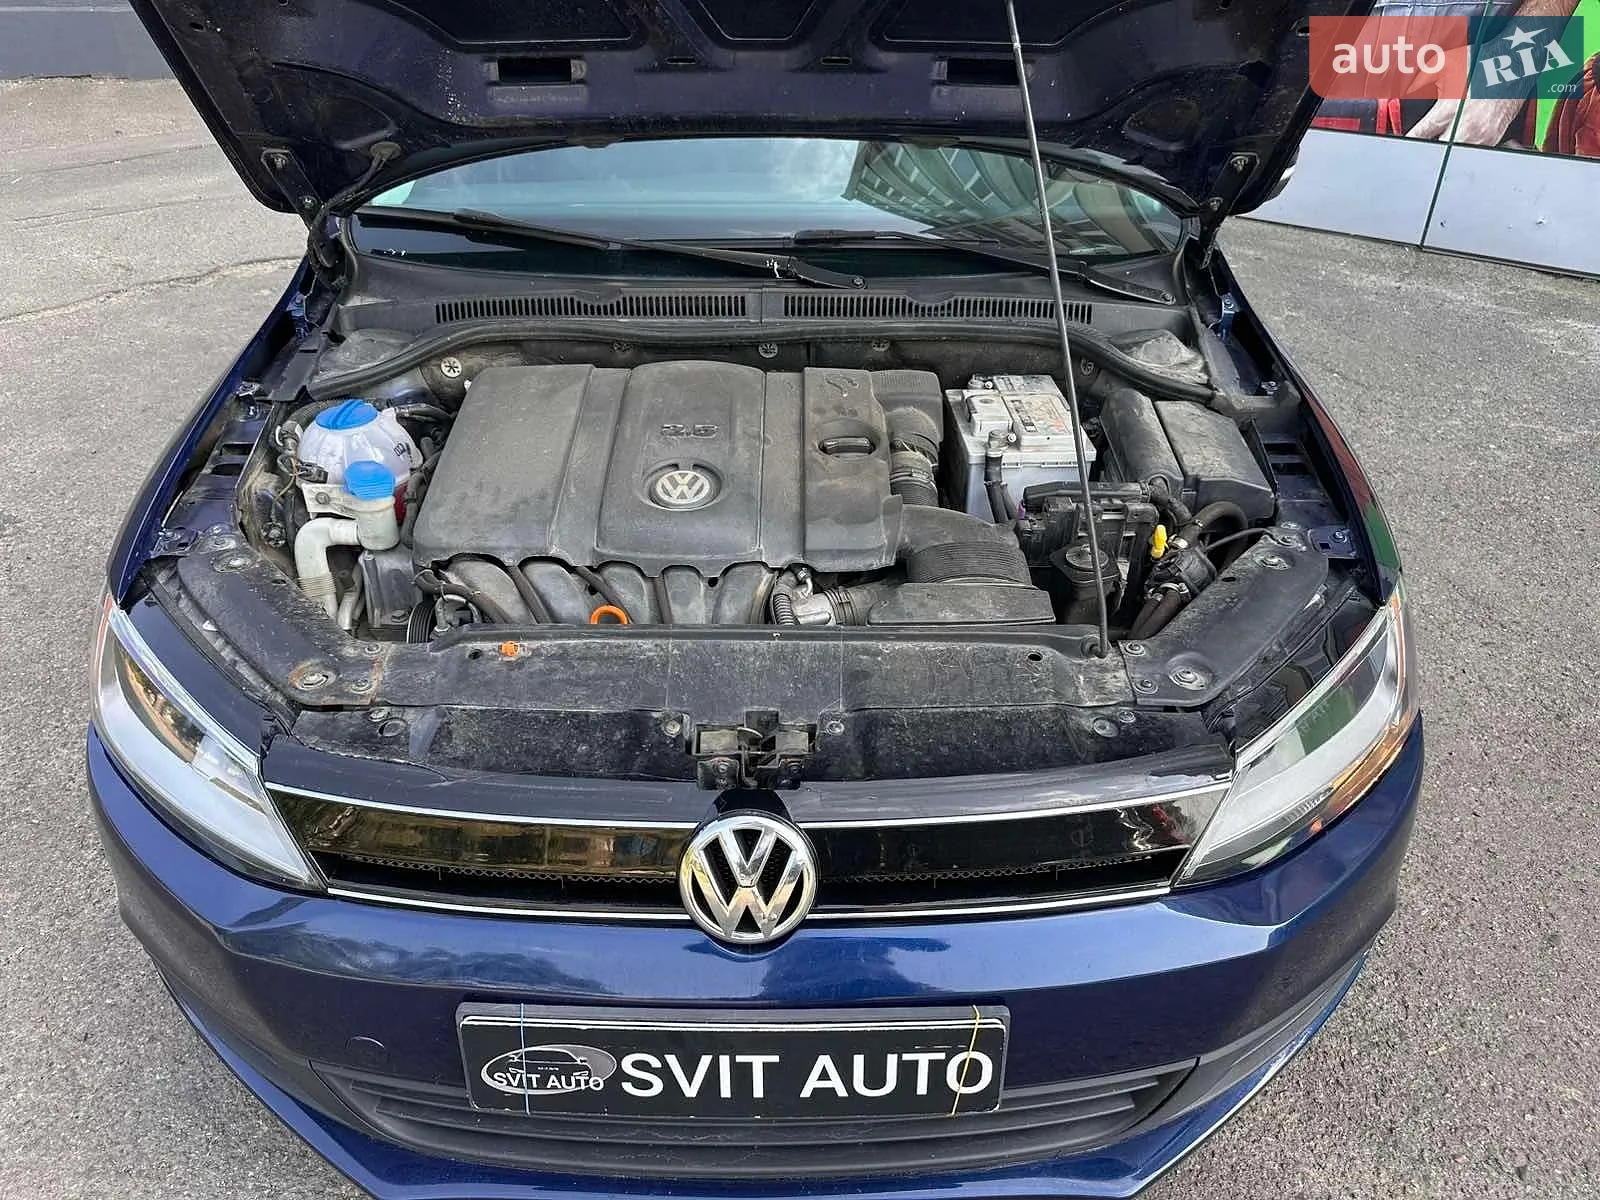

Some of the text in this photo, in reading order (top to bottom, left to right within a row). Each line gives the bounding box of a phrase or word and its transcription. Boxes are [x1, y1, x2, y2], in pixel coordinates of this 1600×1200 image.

[684, 820, 811, 940] VW
[546, 1075, 605, 1091] AUTO
[620, 1050, 994, 1099] SVIT AUTO
